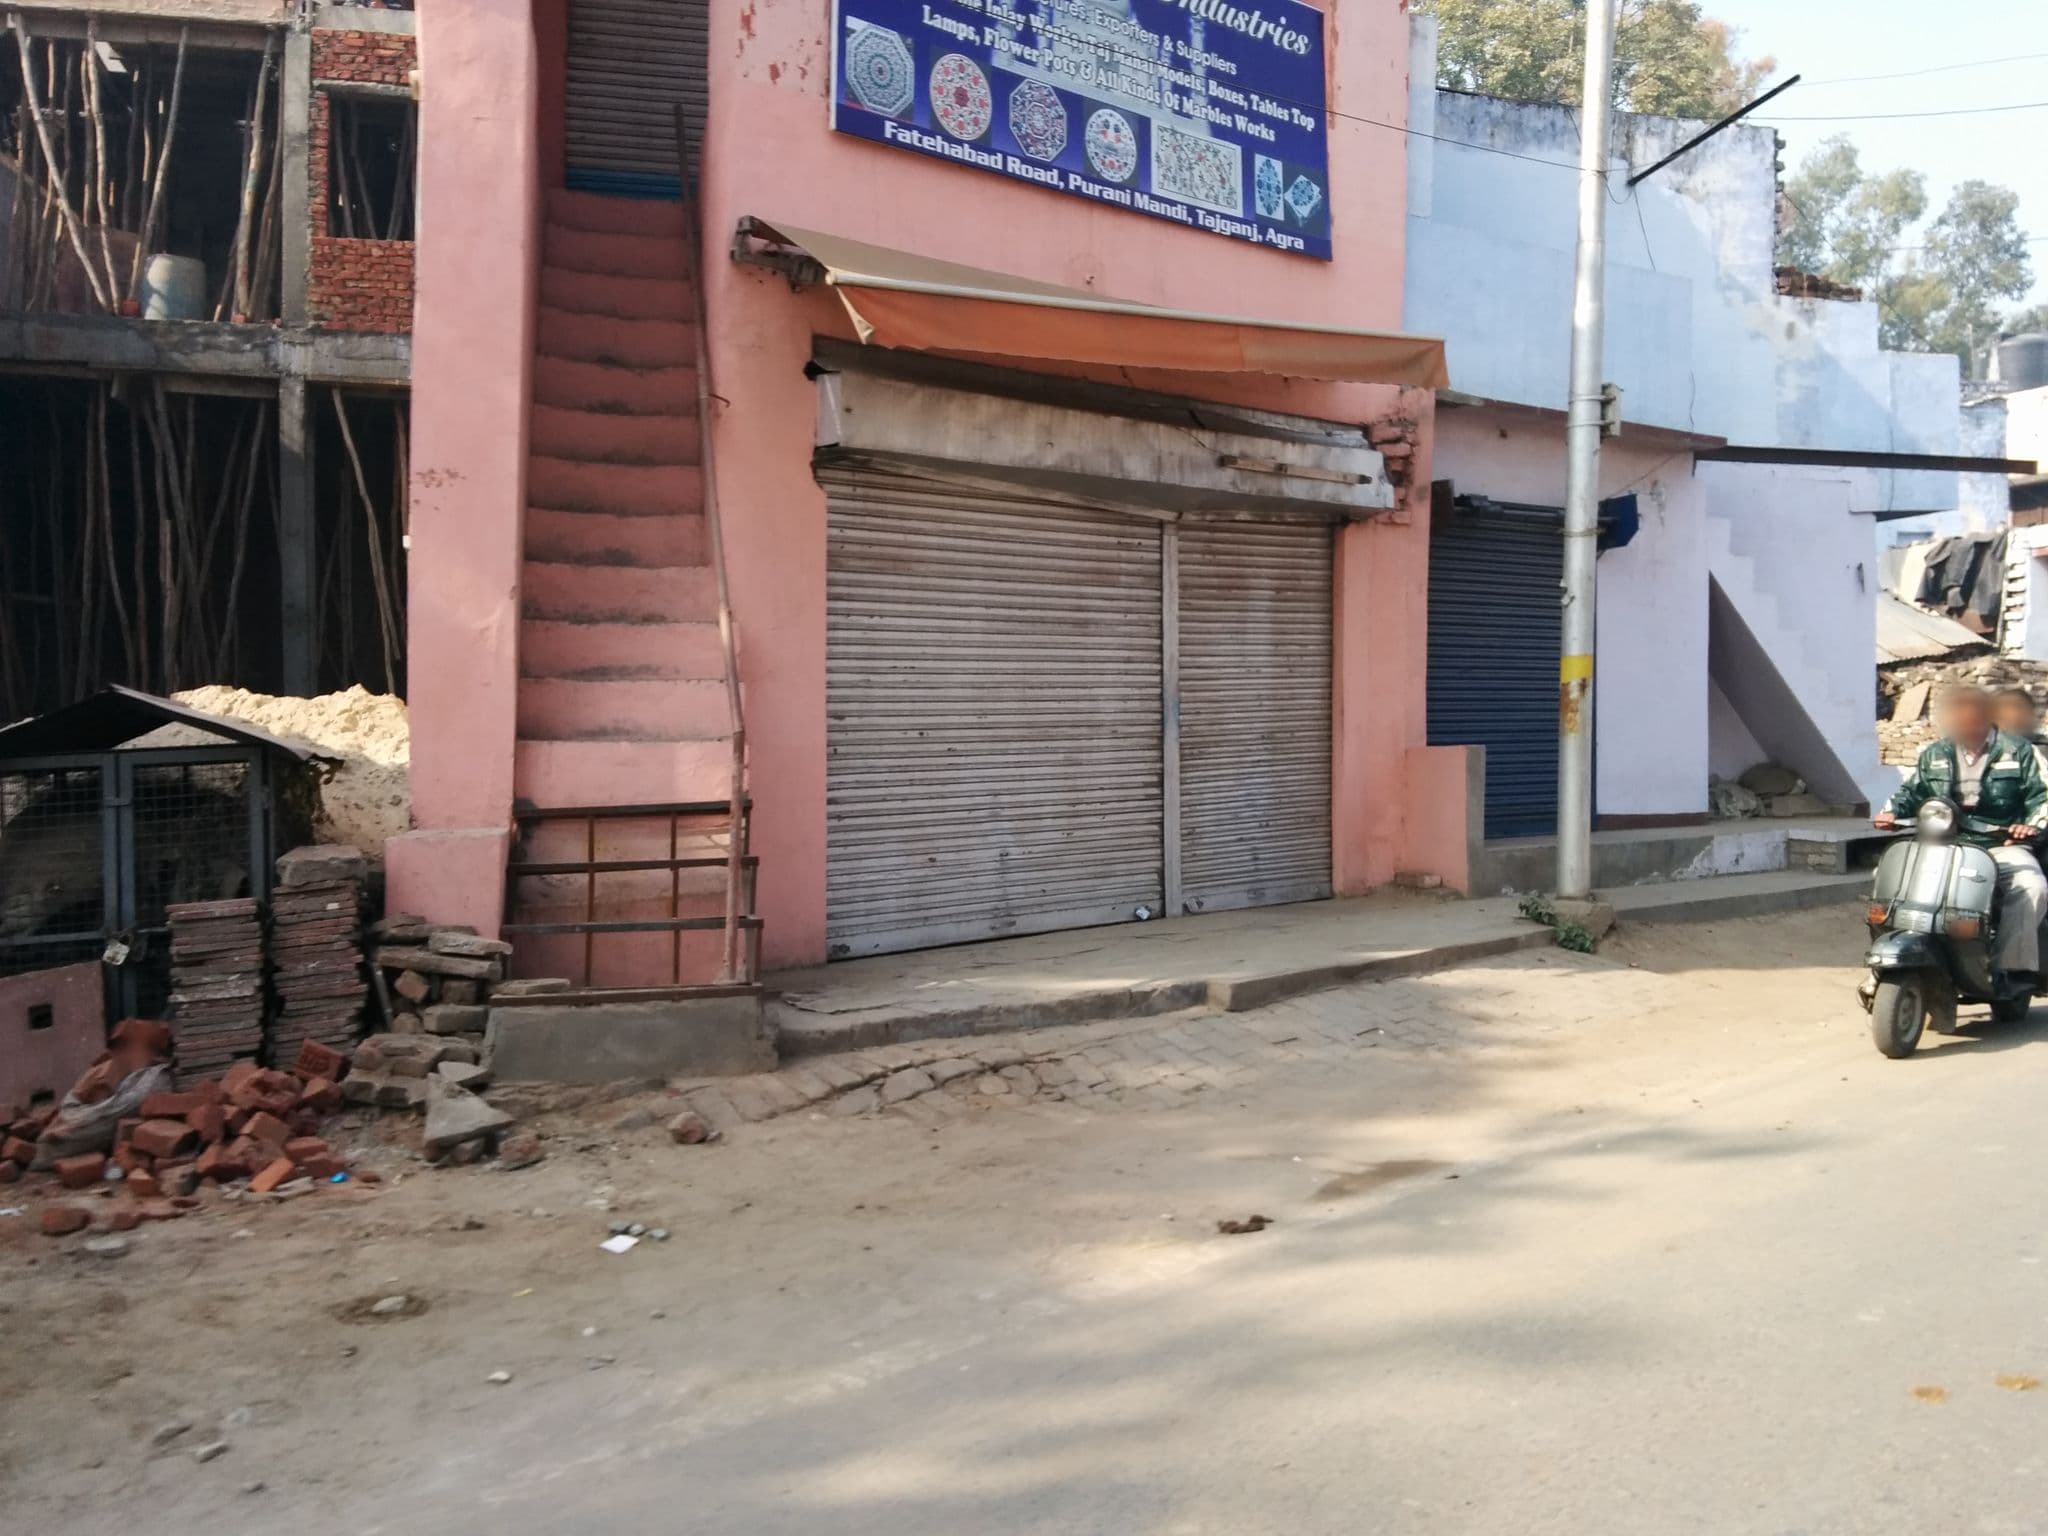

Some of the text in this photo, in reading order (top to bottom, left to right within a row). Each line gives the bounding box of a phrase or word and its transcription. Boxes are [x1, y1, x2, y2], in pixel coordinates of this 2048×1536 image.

[922, 4, 980, 46] Lamps,
[984, 26, 1040, 63] Flower
[1043, 48, 1076, 75] Pots
[1079, 60, 1093, 80] &
[1097, 67, 1118, 89] All
[1121, 75, 1160, 104] Kinds
[1164, 91, 1180, 111] Of
[1182, 96, 1233, 128] Marbles
[1234, 114, 1276, 142] Works
[985, 0, 1026, 31] Inlay
[1087, 33, 1111, 62] Taj
[1113, 44, 1153, 74] Mahal
[1157, 61, 1206, 95] Models,
[1208, 79, 1248, 111] Boxes,
[1250, 94, 1289, 121] Tables
[1291, 108, 1315, 132] Top
[1095, 8, 1160, 47] Exporters
[1163, 35, 1174, 51] &
[1177, 40, 1238, 75] Suppliers
[884, 120, 1304, 250] Fatehabad Road, Purani Mandi, Tajganj, Agra
